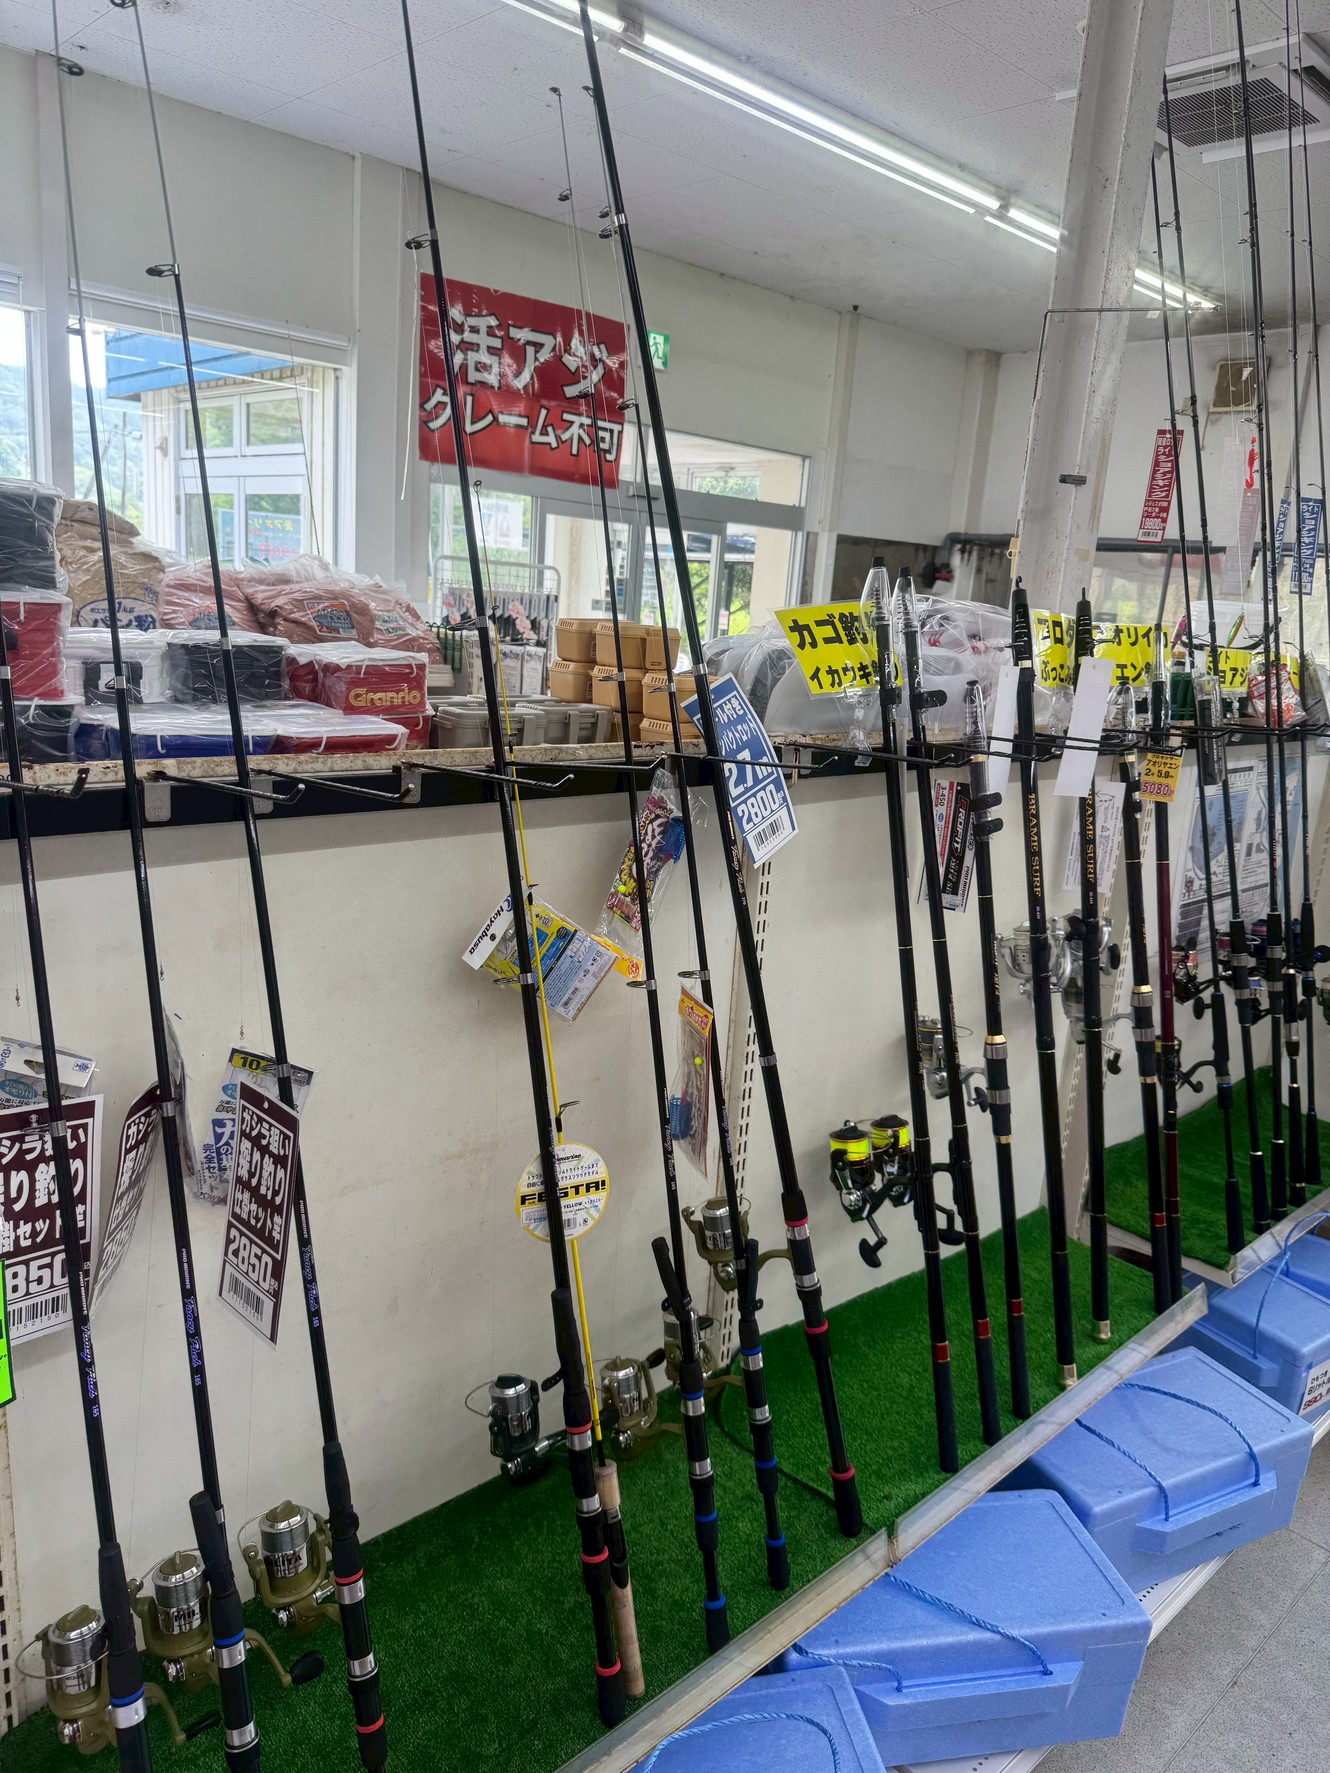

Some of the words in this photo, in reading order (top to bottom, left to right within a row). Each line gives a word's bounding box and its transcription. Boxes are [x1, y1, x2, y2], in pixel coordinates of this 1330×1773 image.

[447, 306, 609, 399] 活アジ
[421, 384, 623, 463] クレーム不可
[1146, 759, 1180, 770] アオリヤエン
[737, 783, 780, 832] 2800
[939, 785, 947, 807] 3-450
[1085, 787, 1094, 841] RAME
[953, 799, 967, 854] PROFIT
[1027, 794, 1040, 851] BRAME
[1031, 856, 1041, 898] SURF
[1086, 843, 1095, 884] SURF
[469, 905, 504, 956] Hayabusa
[239, 1056, 262, 1071] 10
[241, 1107, 289, 1157] ガシラ狙い
[237, 1136, 286, 1207] 探り釣り
[232, 1183, 282, 1244] 仕掛セット竿
[227, 1227, 273, 1291] 2850
[184, 1296, 198, 1336] Fancy
[312, 1315, 320, 1328] 165
[186, 1336, 201, 1368] Pack
[193, 1373, 202, 1387] 165
[91, 1404, 100, 1418] 165
